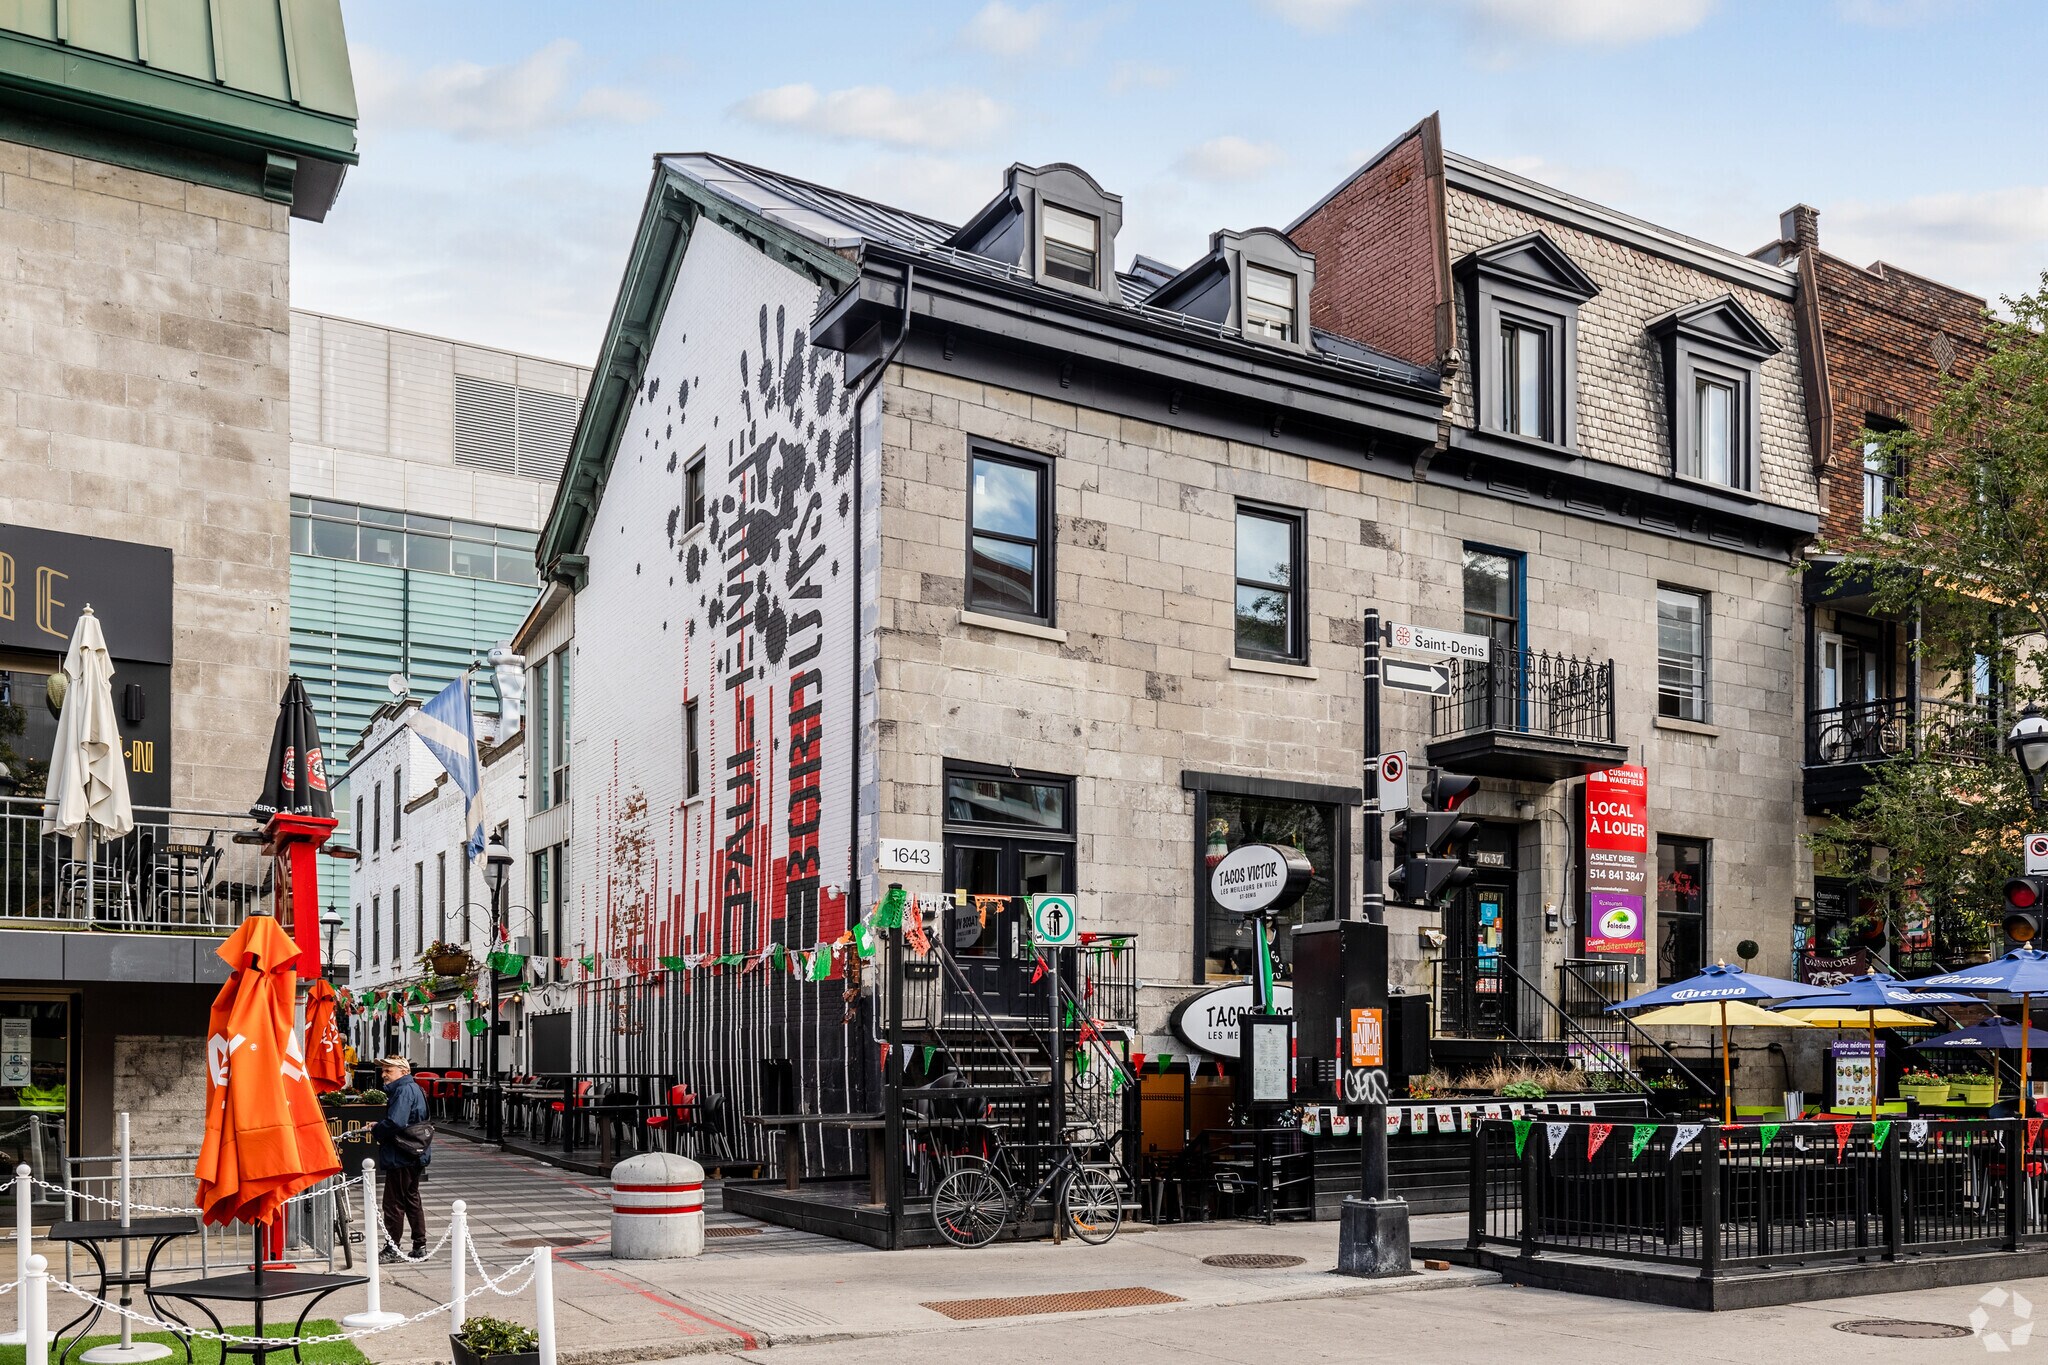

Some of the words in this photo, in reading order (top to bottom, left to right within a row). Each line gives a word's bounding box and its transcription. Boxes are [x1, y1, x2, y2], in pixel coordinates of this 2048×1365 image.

[1414, 635, 1485, 657] Saint-Denis
[709, 640, 717, 714] TRANQUILLE
[787, 493, 824, 897] BORDUAS
[1609, 769, 1638, 778] CUSHMAN
[1609, 776, 1644, 786] WAKEFIELD
[1590, 801, 1634, 817] LOCAL
[1590, 816, 1600, 833] À
[1604, 820, 1645, 837] LOUER
[892, 847, 930, 865] 1643
[1479, 852, 1503, 865] 1637
[1590, 853, 1618, 861] ASHLEY
[1619, 855, 1635, 863] DERE
[1219, 867, 1245, 887] TACOS
[1247, 861, 1278, 881] VICTOR
[1590, 869, 1606, 879] 514
[1608, 870, 1624, 880] 841
[1625, 871, 1645, 882] 3847
[1230, 884, 1255, 893] MEILLEURS
[1264, 880, 1278, 888] VILLE
[1587, 938, 1606, 946] Cuisine
[1596, 940, 1645, 952] méditerranéenne
[1804, 955, 1857, 968] OMNIVORE
[1671, 987, 1747, 1000] Cuervo
[1208, 1031, 1223, 1040] LES
[1357, 1021, 1381, 1044] NIMA
[1833, 1041, 1849, 1049] Cuisine
[10, 1054, 23, 1062] ICI
[1333, 1116, 1346, 1125] XX
[1387, 1116, 1399, 1125] XX
[1439, 1114, 1451, 1123] XX
